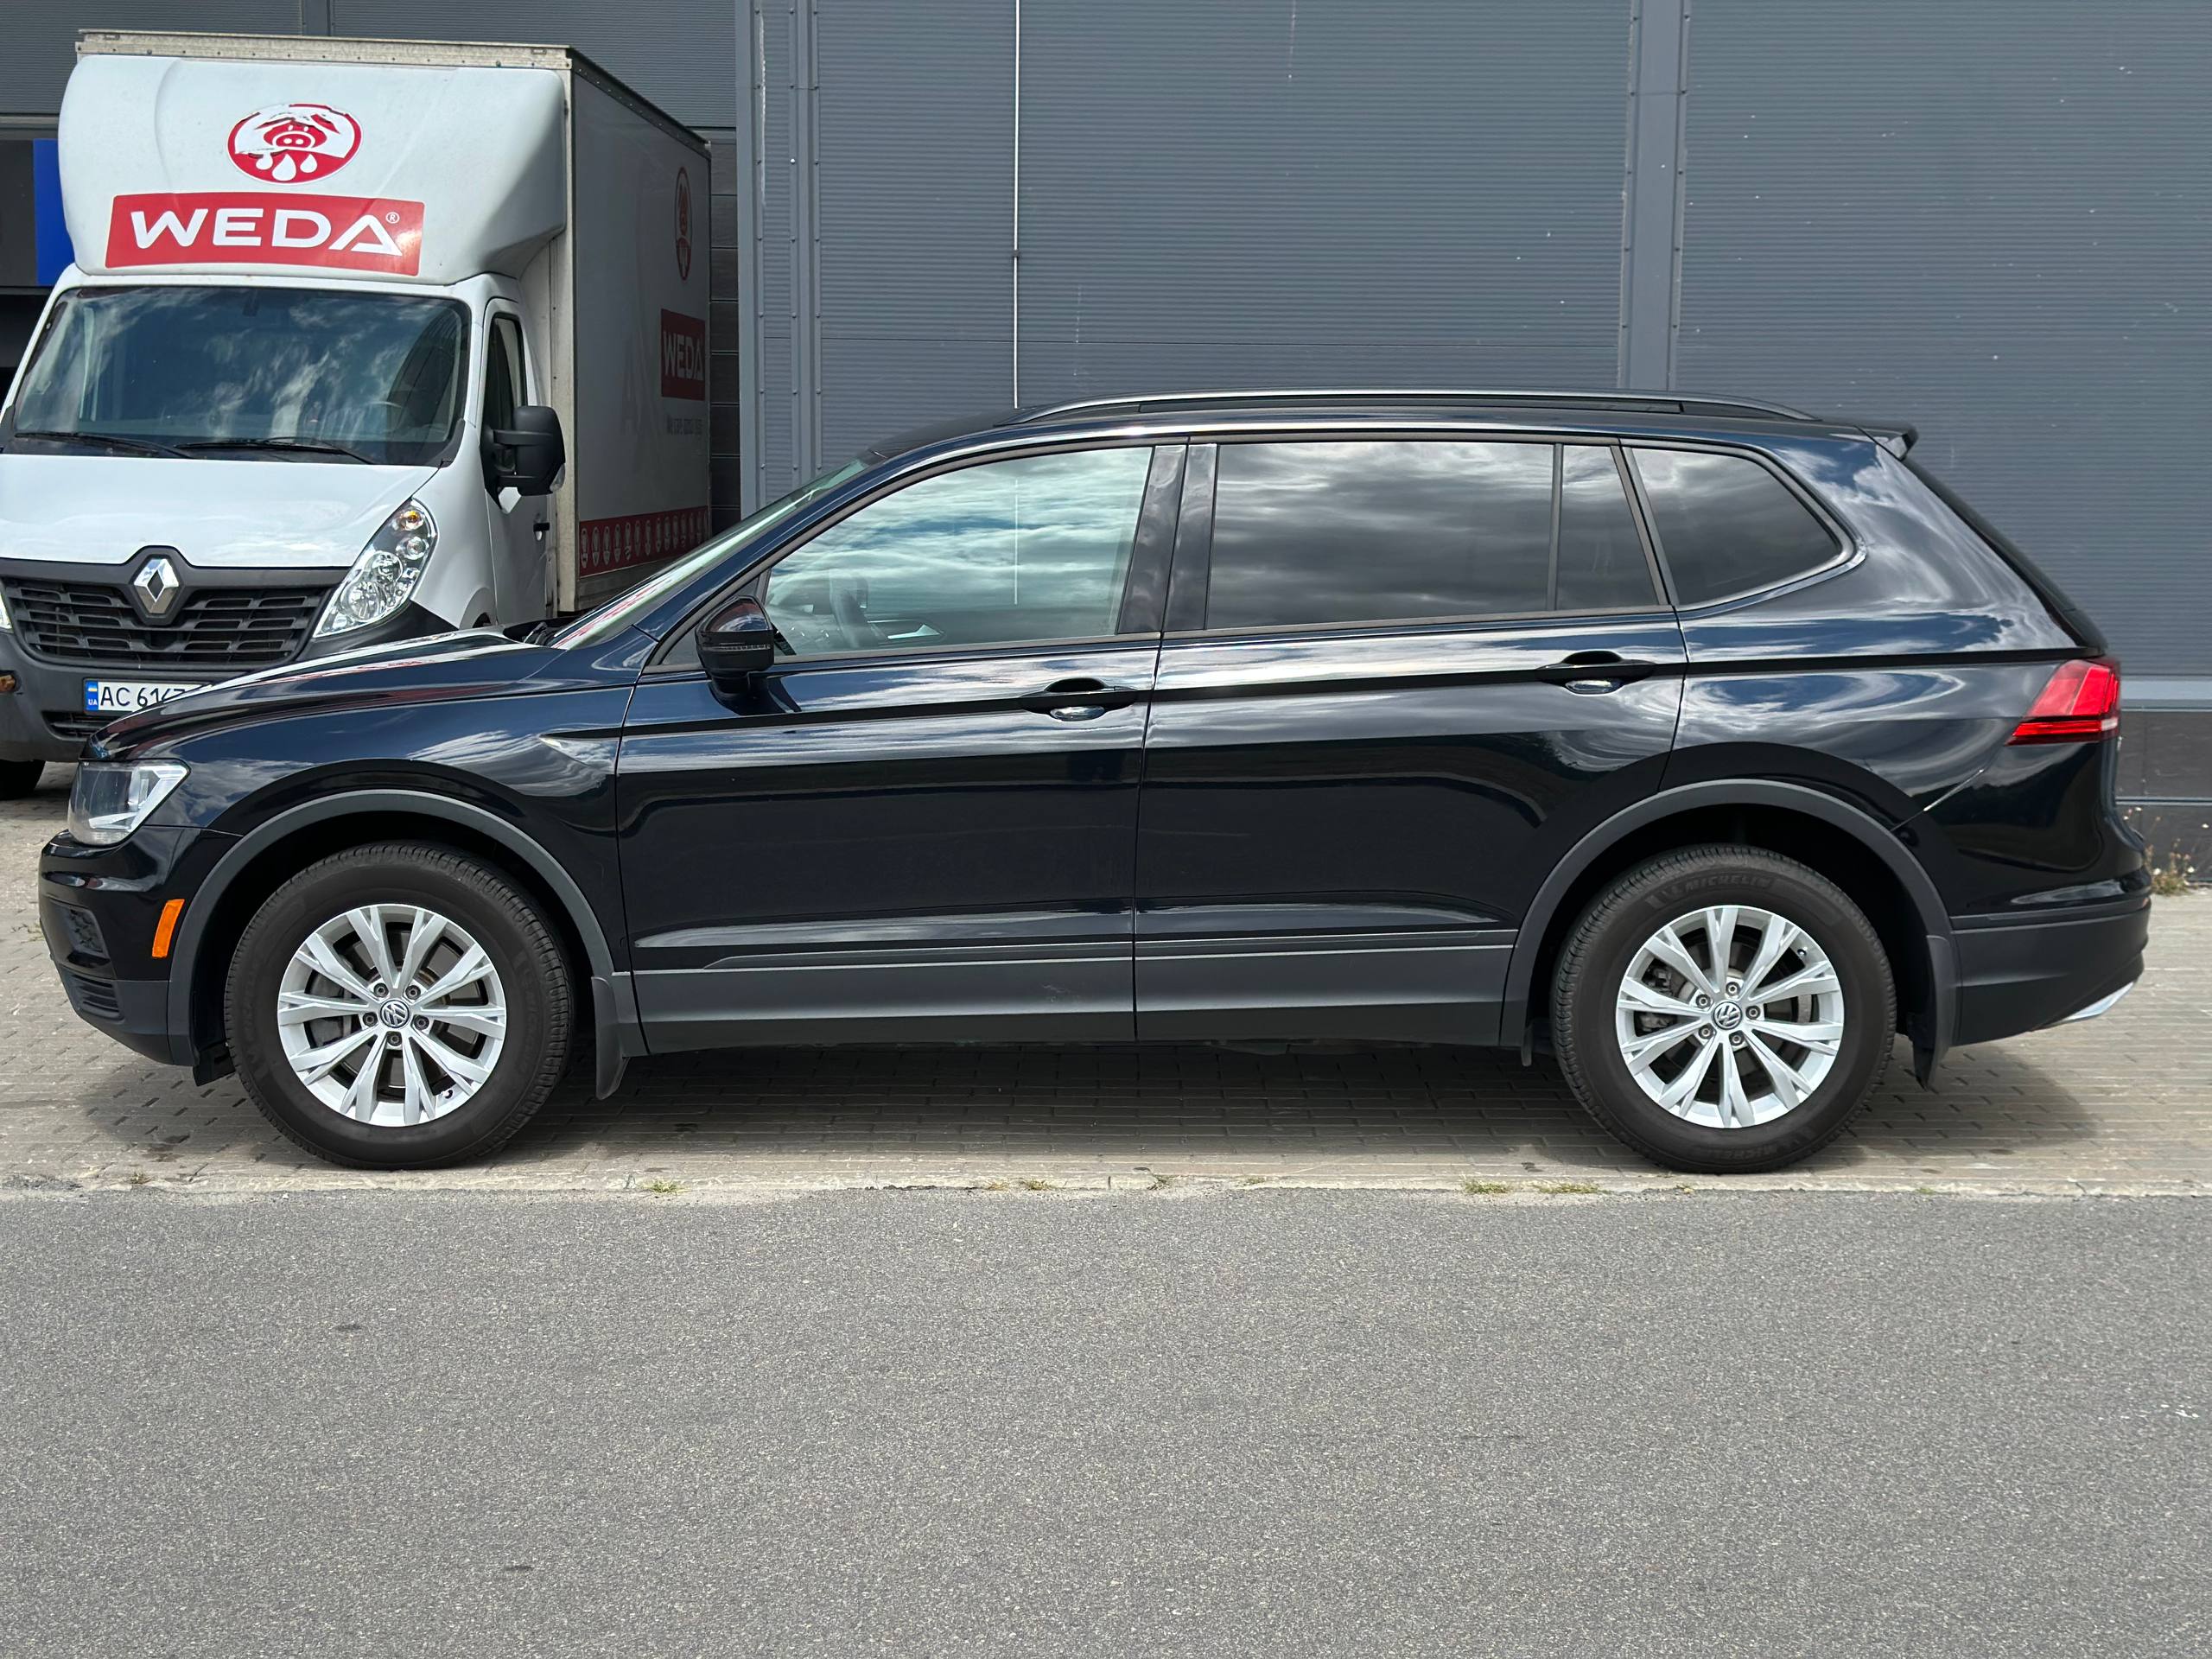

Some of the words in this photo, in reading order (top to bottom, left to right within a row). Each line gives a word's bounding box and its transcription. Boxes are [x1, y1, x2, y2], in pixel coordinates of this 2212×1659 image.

[663, 331, 704, 381] WEDA
[100, 686, 130, 707] AC
[1685, 874, 1772, 893] MICHELIN
